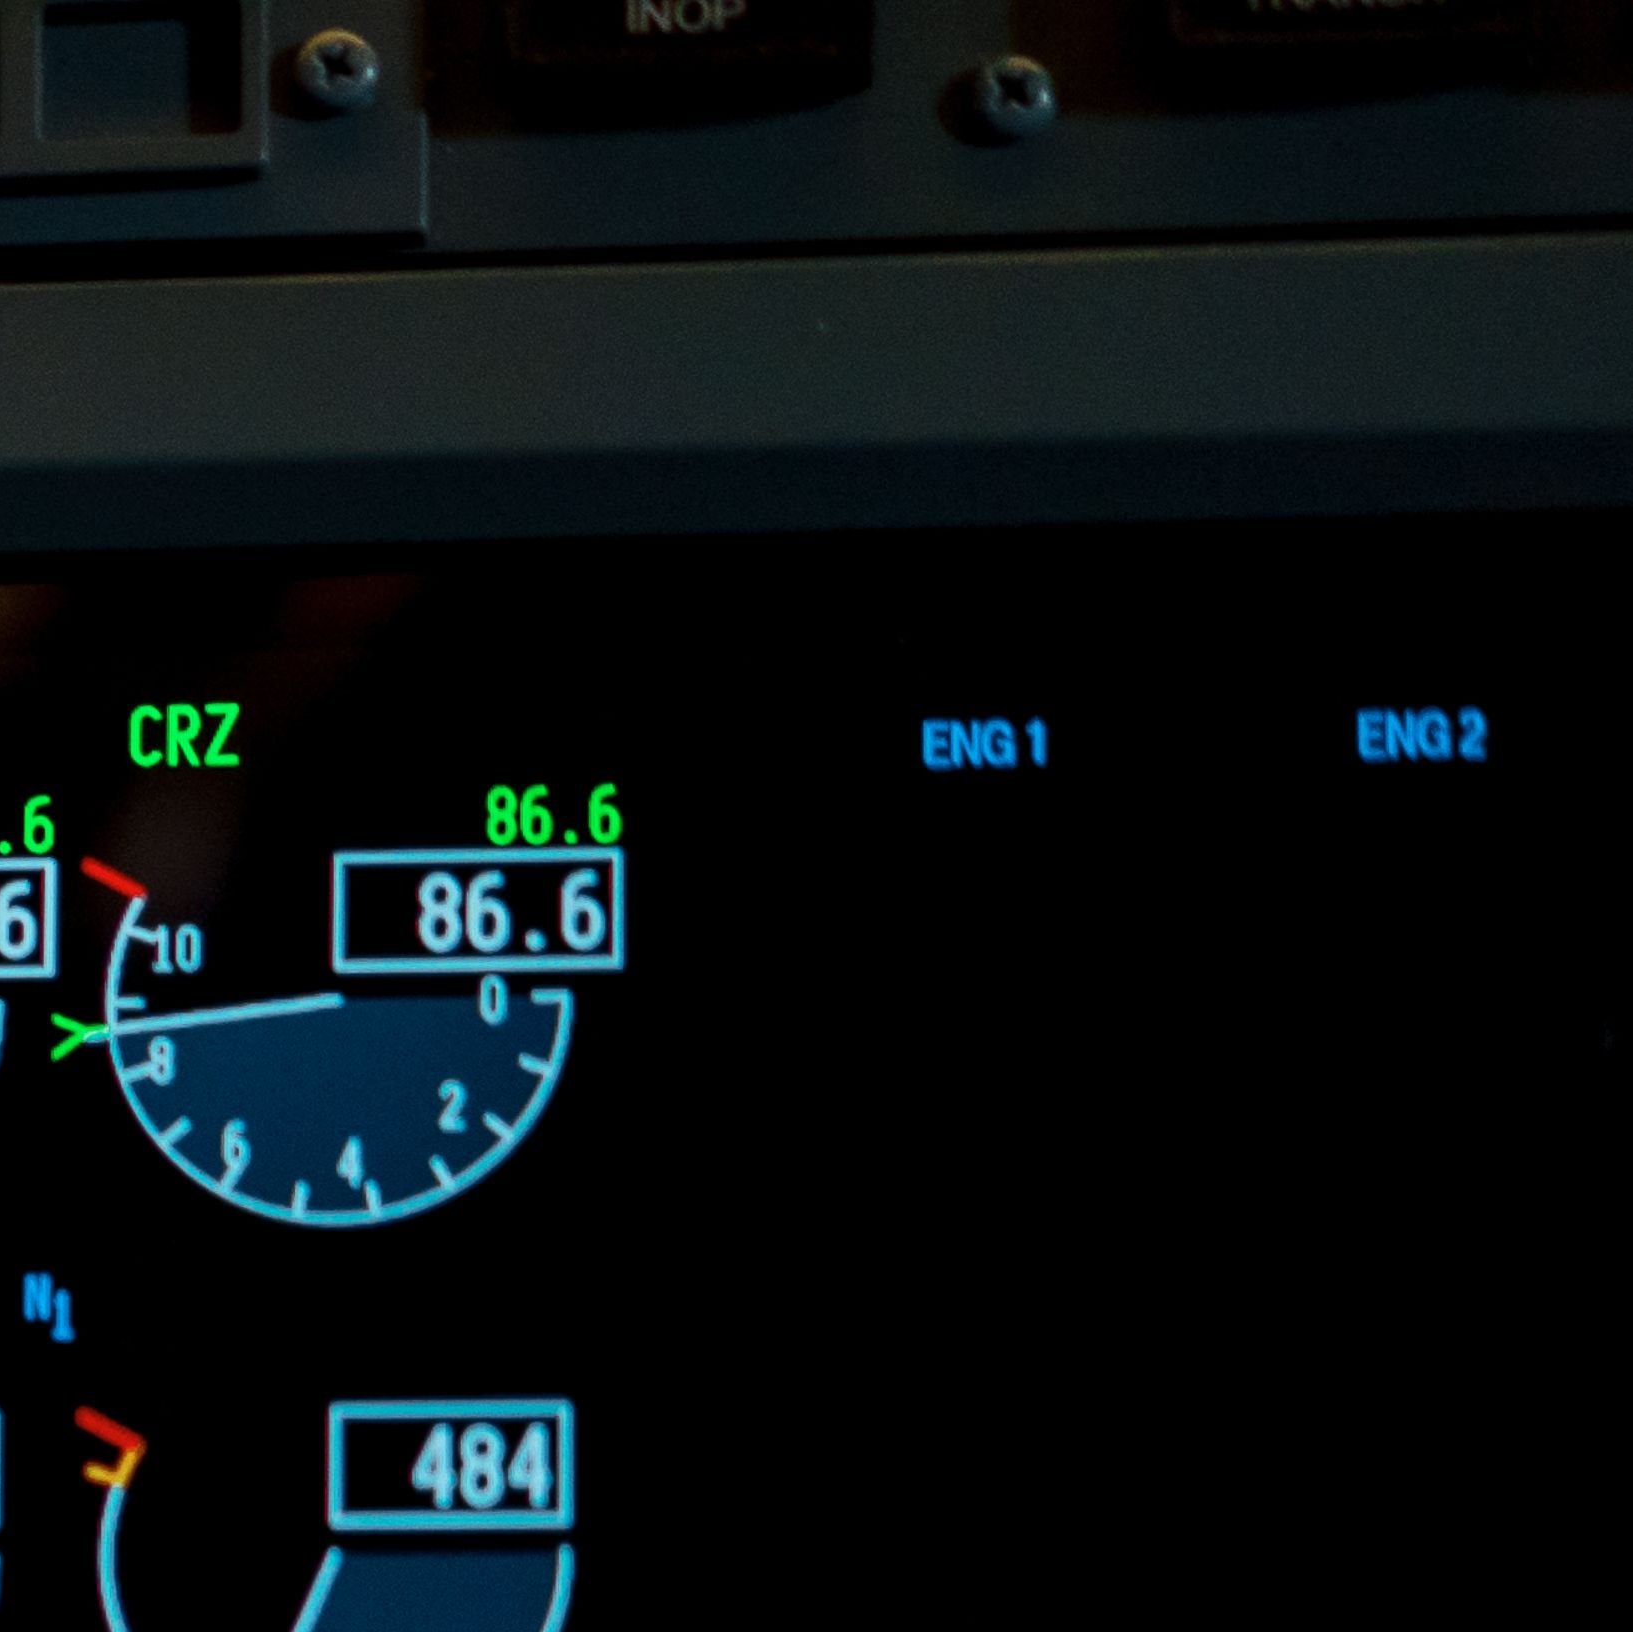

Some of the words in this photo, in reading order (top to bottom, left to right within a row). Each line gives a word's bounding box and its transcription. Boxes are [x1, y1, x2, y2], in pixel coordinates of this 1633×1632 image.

[129, 702, 240, 768] CRZ
[922, 718, 1017, 769] ENG
[1026, 718, 1047, 766] 1
[1357, 709, 1453, 761] ENG
[1458, 707, 1487, 760] 2
[486, 783, 622, 847] 86.6
[417, 867, 607, 953] 86.6
[151, 922, 203, 973] 10
[477, 973, 508, 1026] 0
[147, 1035, 176, 1085] 8
[437, 1079, 468, 1133] 2
[220, 1118, 251, 1169] 6
[336, 1134, 366, 1188] 4
[410, 1422, 552, 1510] 484
